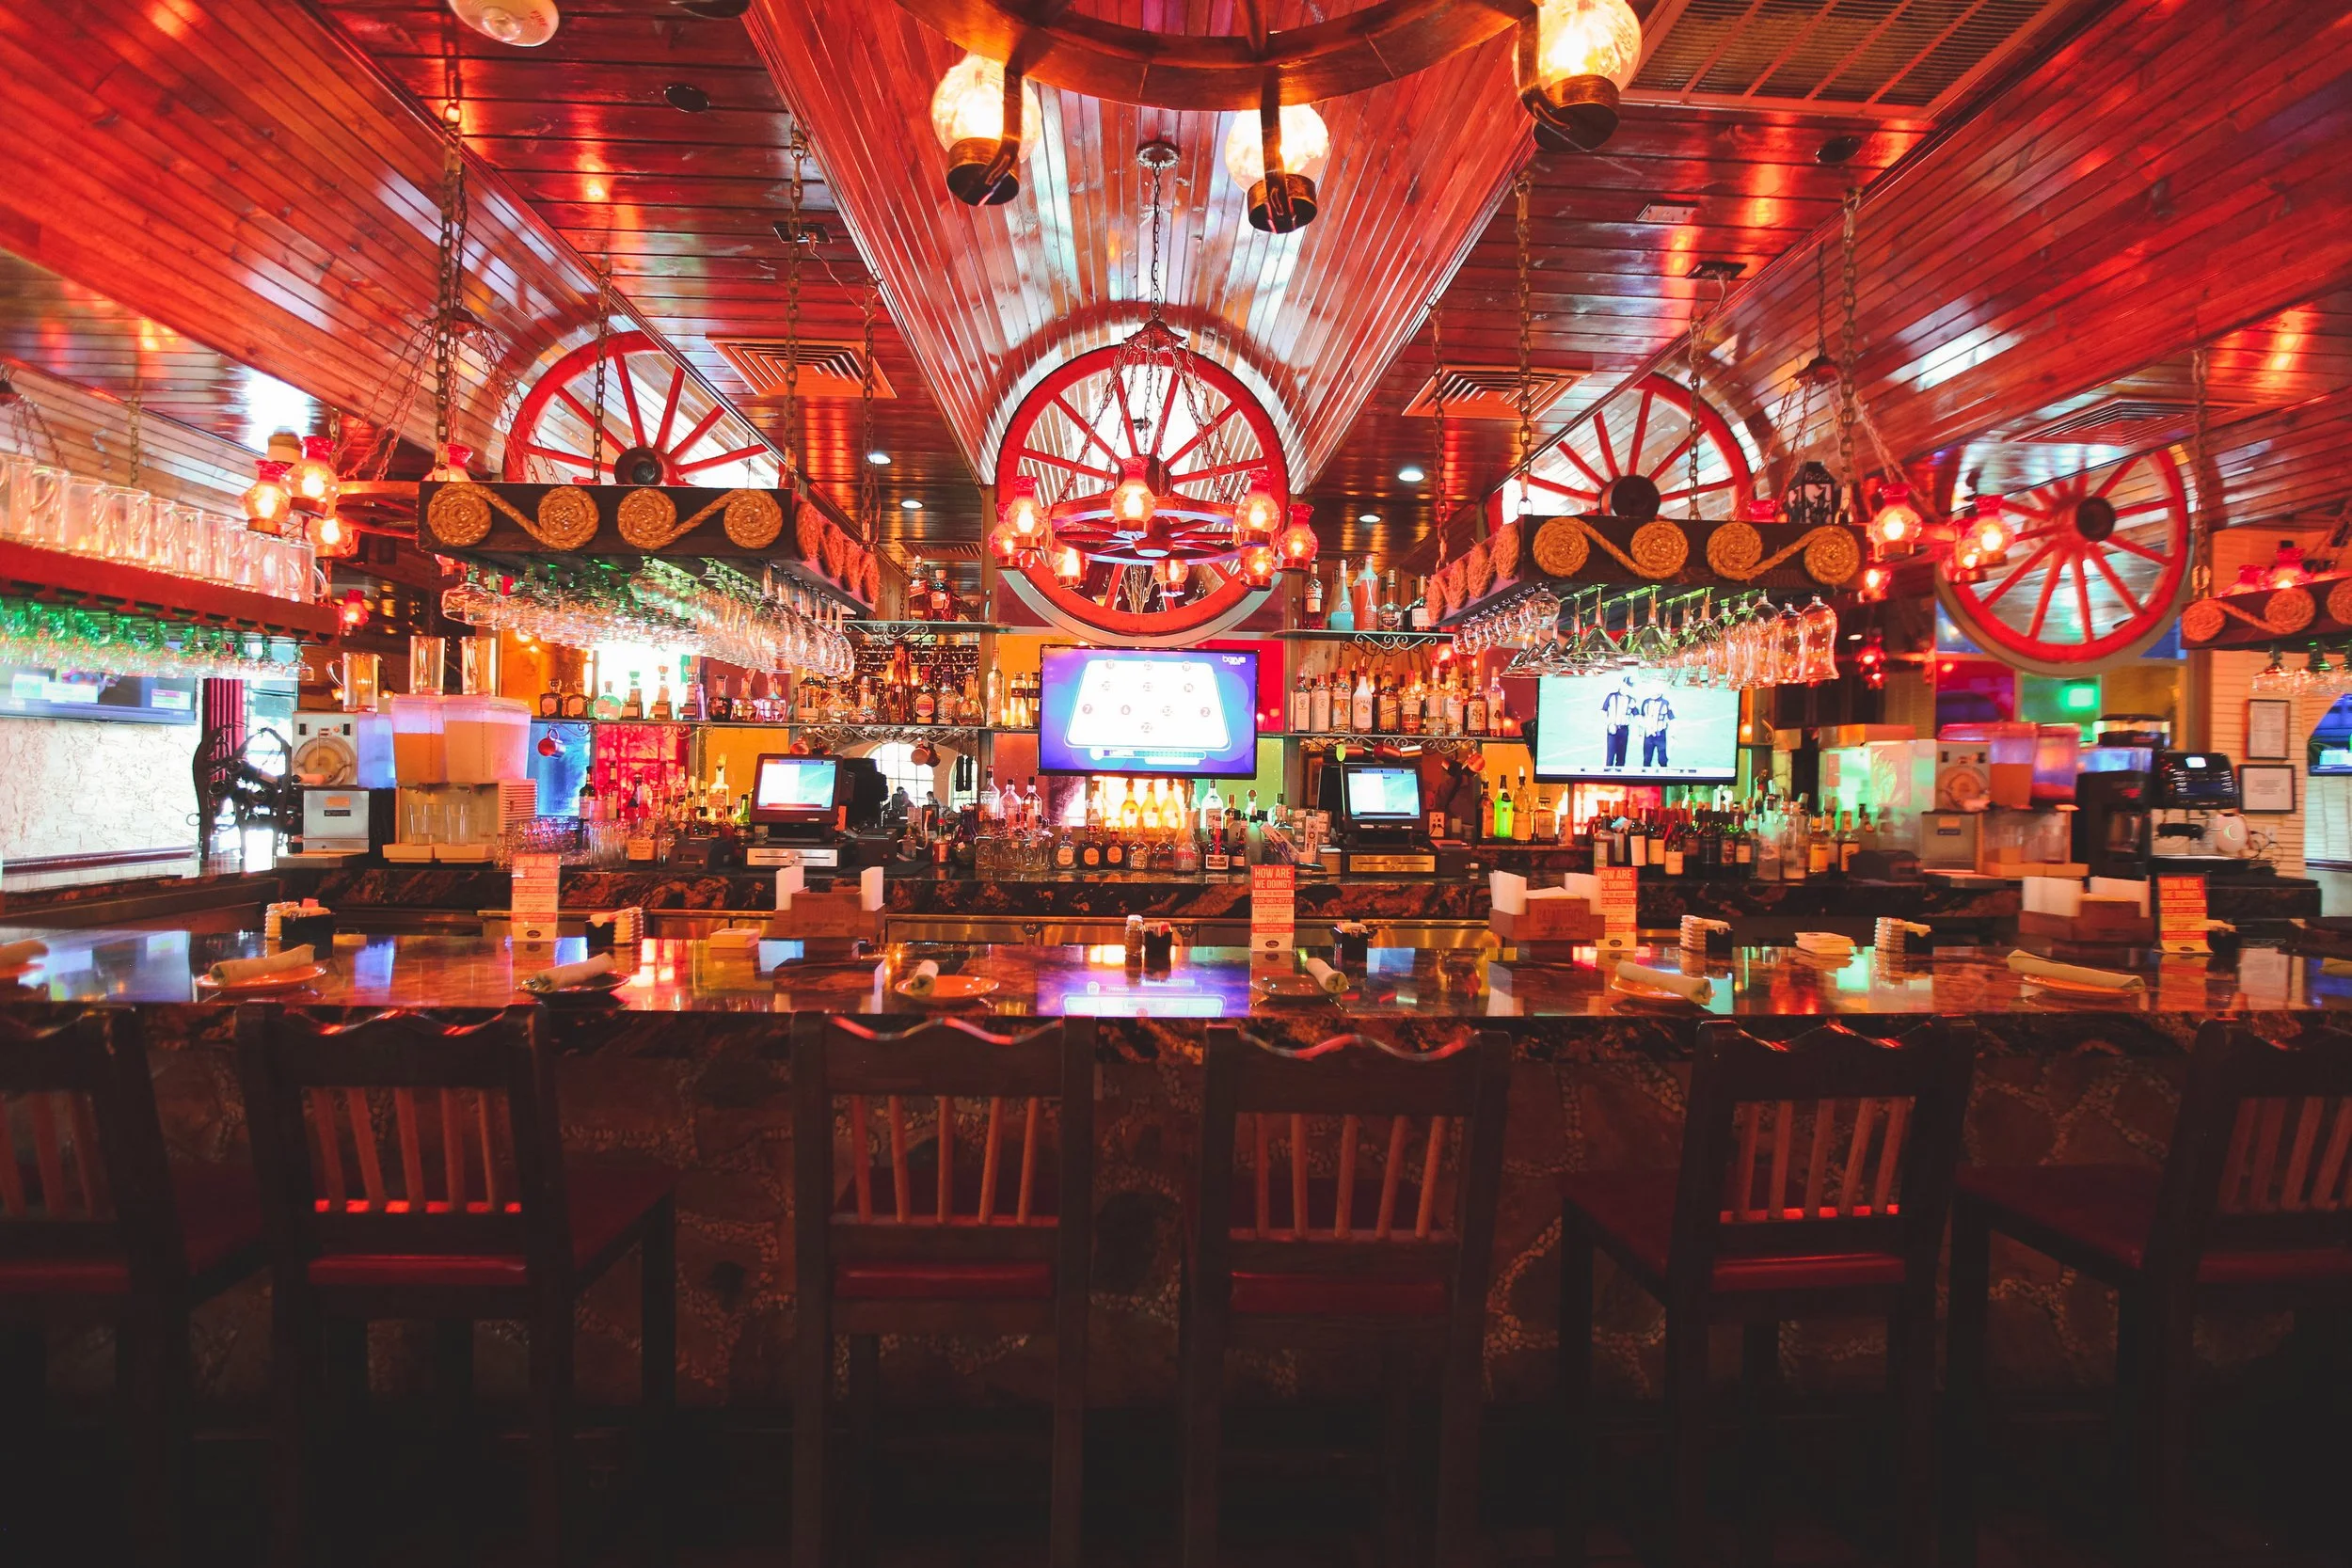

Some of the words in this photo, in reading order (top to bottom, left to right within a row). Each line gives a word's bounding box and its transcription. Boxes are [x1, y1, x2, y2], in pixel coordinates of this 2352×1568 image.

[1255, 868, 1273, 879] HOW
[1275, 868, 1291, 879] ARE
[1617, 869, 1632, 879] ARE
[1255, 879, 1265, 889] WE
[1266, 879, 1292, 889] DOING?
